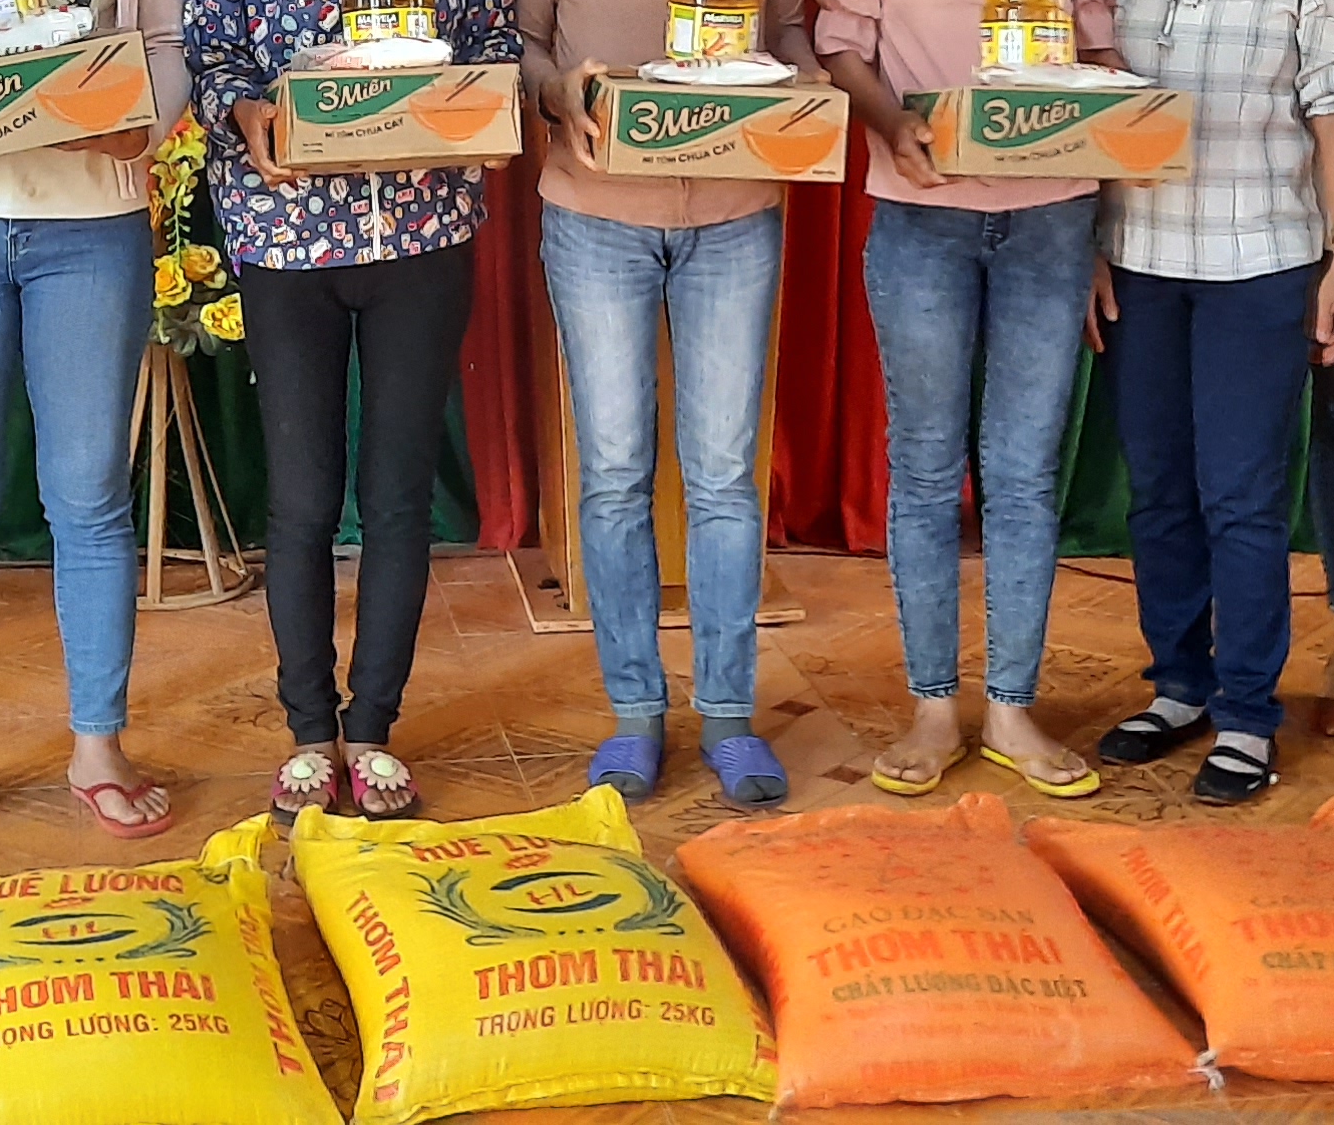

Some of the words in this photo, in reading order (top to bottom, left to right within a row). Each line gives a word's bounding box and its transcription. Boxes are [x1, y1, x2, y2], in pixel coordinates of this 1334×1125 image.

[12, 107, 38, 129] CAY
[473, 948, 599, 1001] THƠM
[167, 1013, 231, 1035] 25KG
[475, 1005, 556, 1038] TRỌNG
[660, 1001, 716, 1027] 25KG
